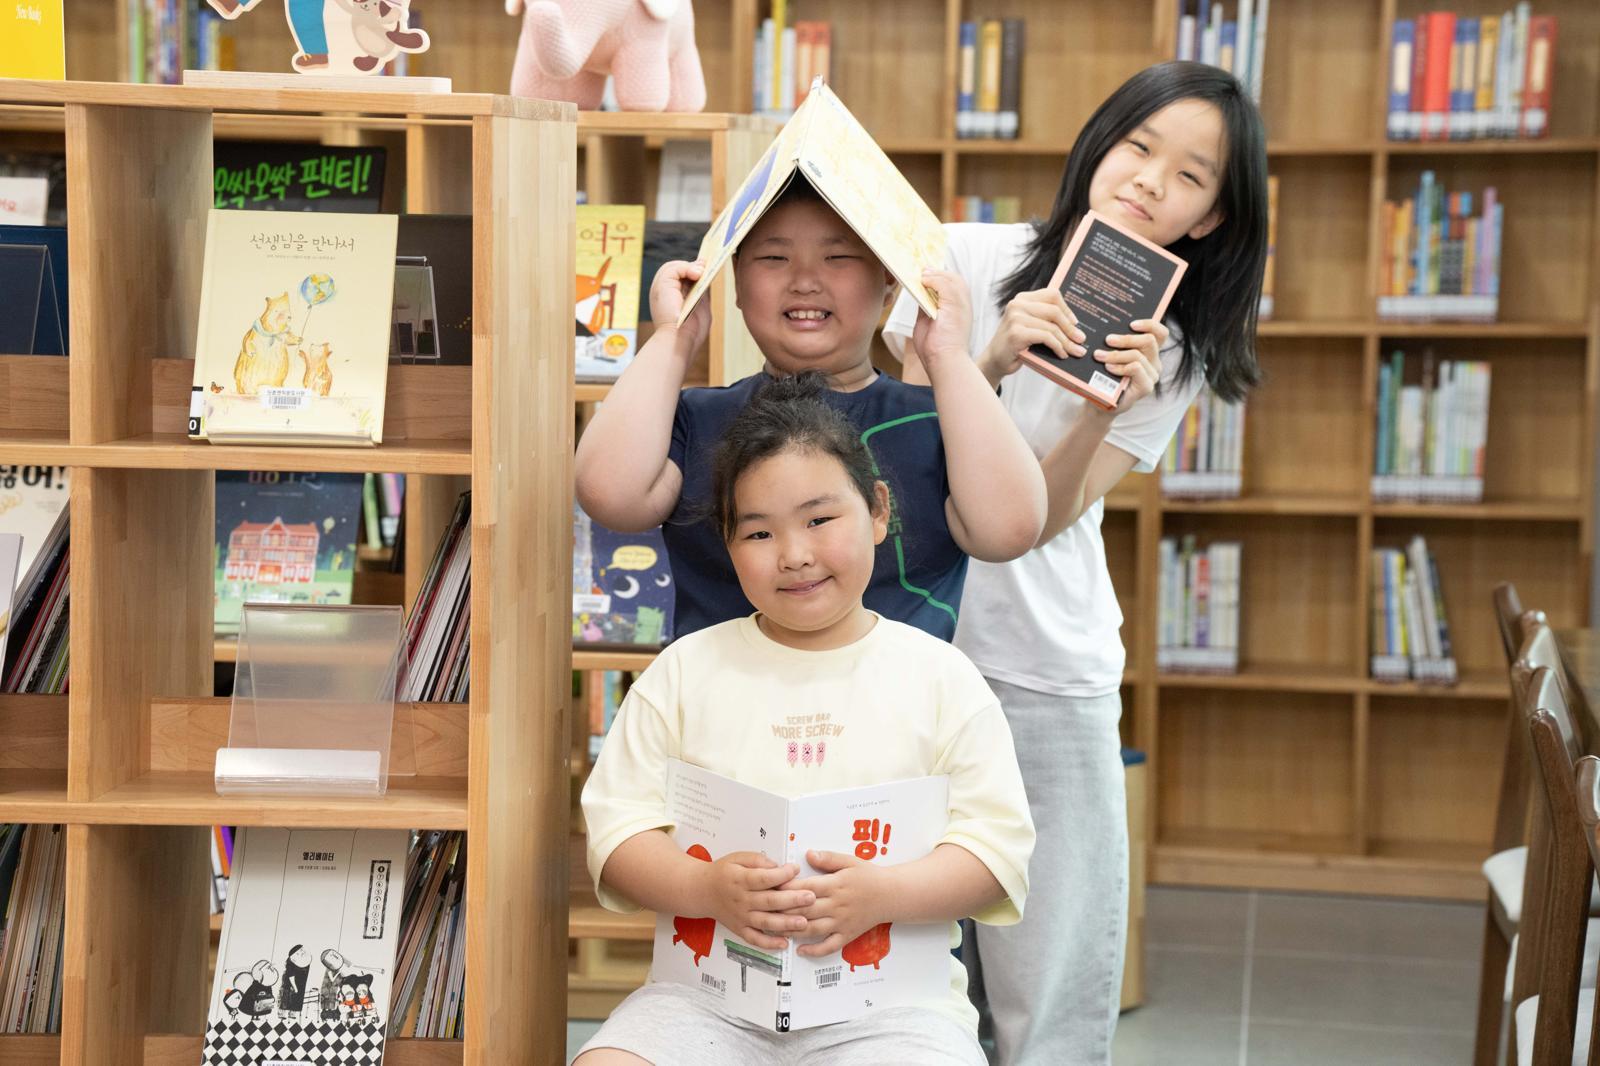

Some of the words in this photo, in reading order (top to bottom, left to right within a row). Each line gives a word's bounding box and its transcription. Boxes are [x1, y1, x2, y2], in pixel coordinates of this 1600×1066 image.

[214, 162, 296, 209] 오싹오싹
[299, 154, 372, 198] 팬티!
[249, 232, 309, 252] 선생님을
[312, 235, 355, 253] 만나서
[580, 221, 636, 255] 여우
[771, 723, 802, 739] MORE
[805, 723, 845, 738] SCREW
[852, 818, 892, 861] 핑!
[302, 851, 335, 862] 엘리베이터
